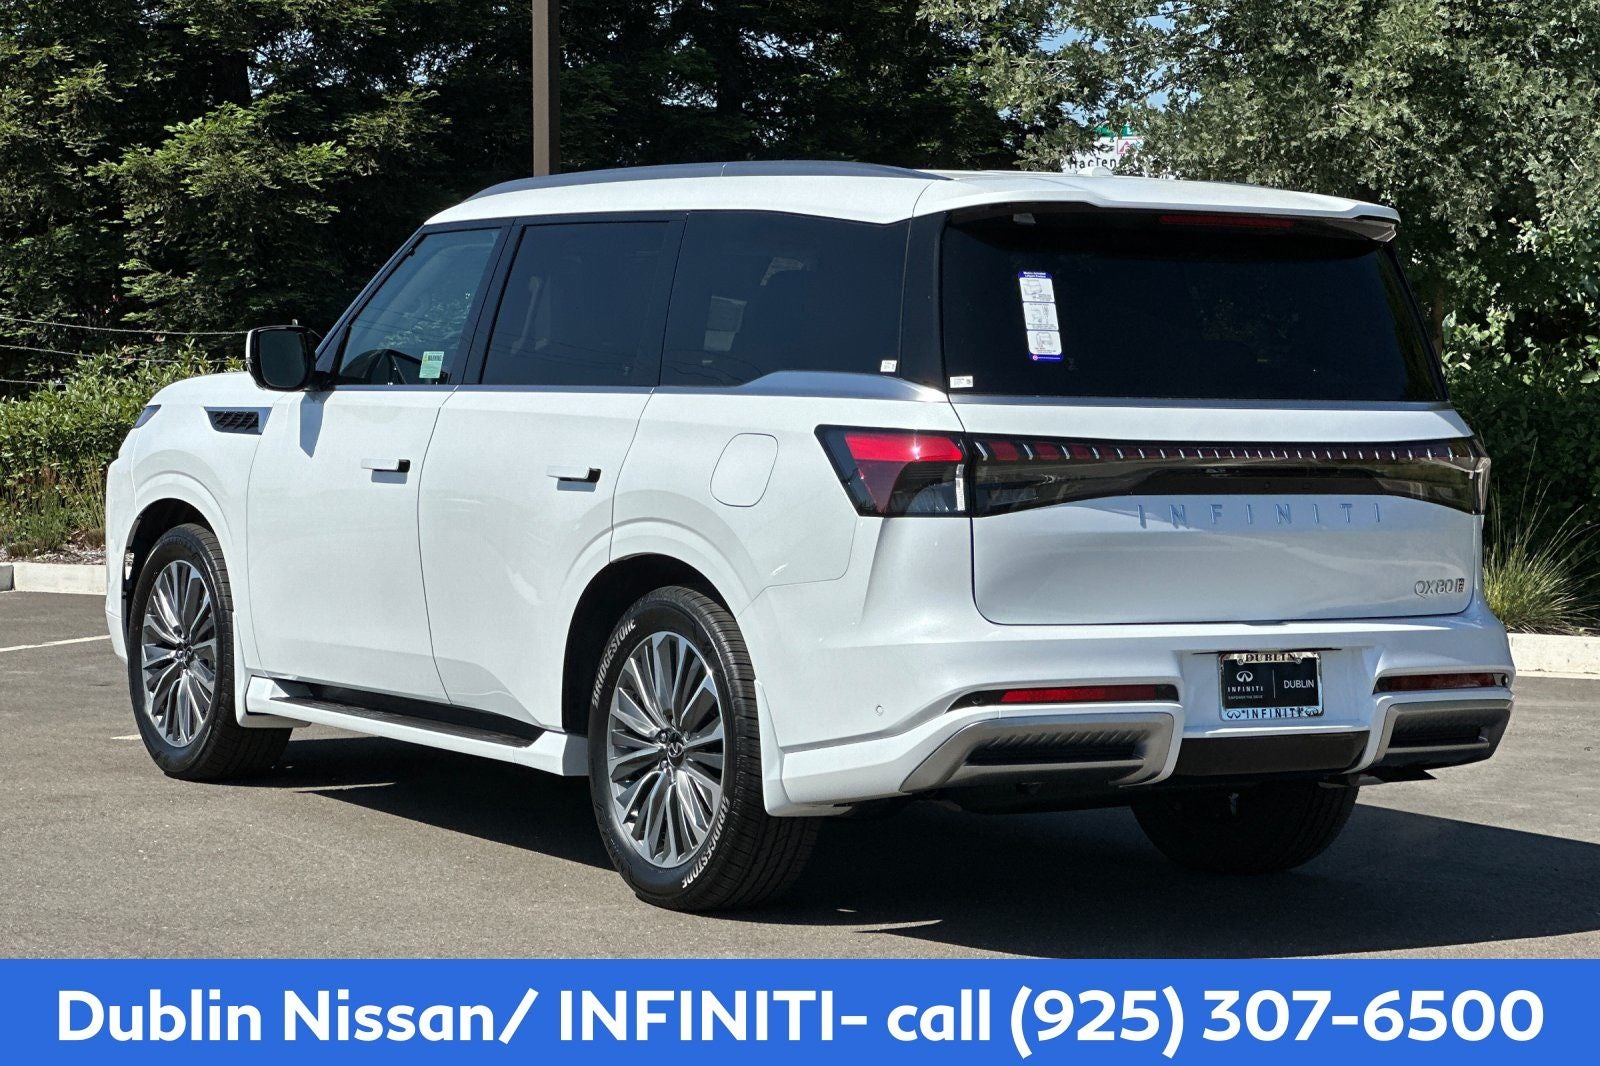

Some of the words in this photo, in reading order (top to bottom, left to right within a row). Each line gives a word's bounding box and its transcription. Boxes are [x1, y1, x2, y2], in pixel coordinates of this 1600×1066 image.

[1137, 503, 1380, 529] INFINITI
[1414, 578, 1454, 598] QX80
[592, 619, 636, 710] BRIDGESTONE
[1245, 653, 1296, 662] DUBLIN
[1284, 680, 1314, 688] DUBLIN
[1246, 707, 1302, 719] INFINITI
[682, 796, 731, 889] BRIDGESTONE
